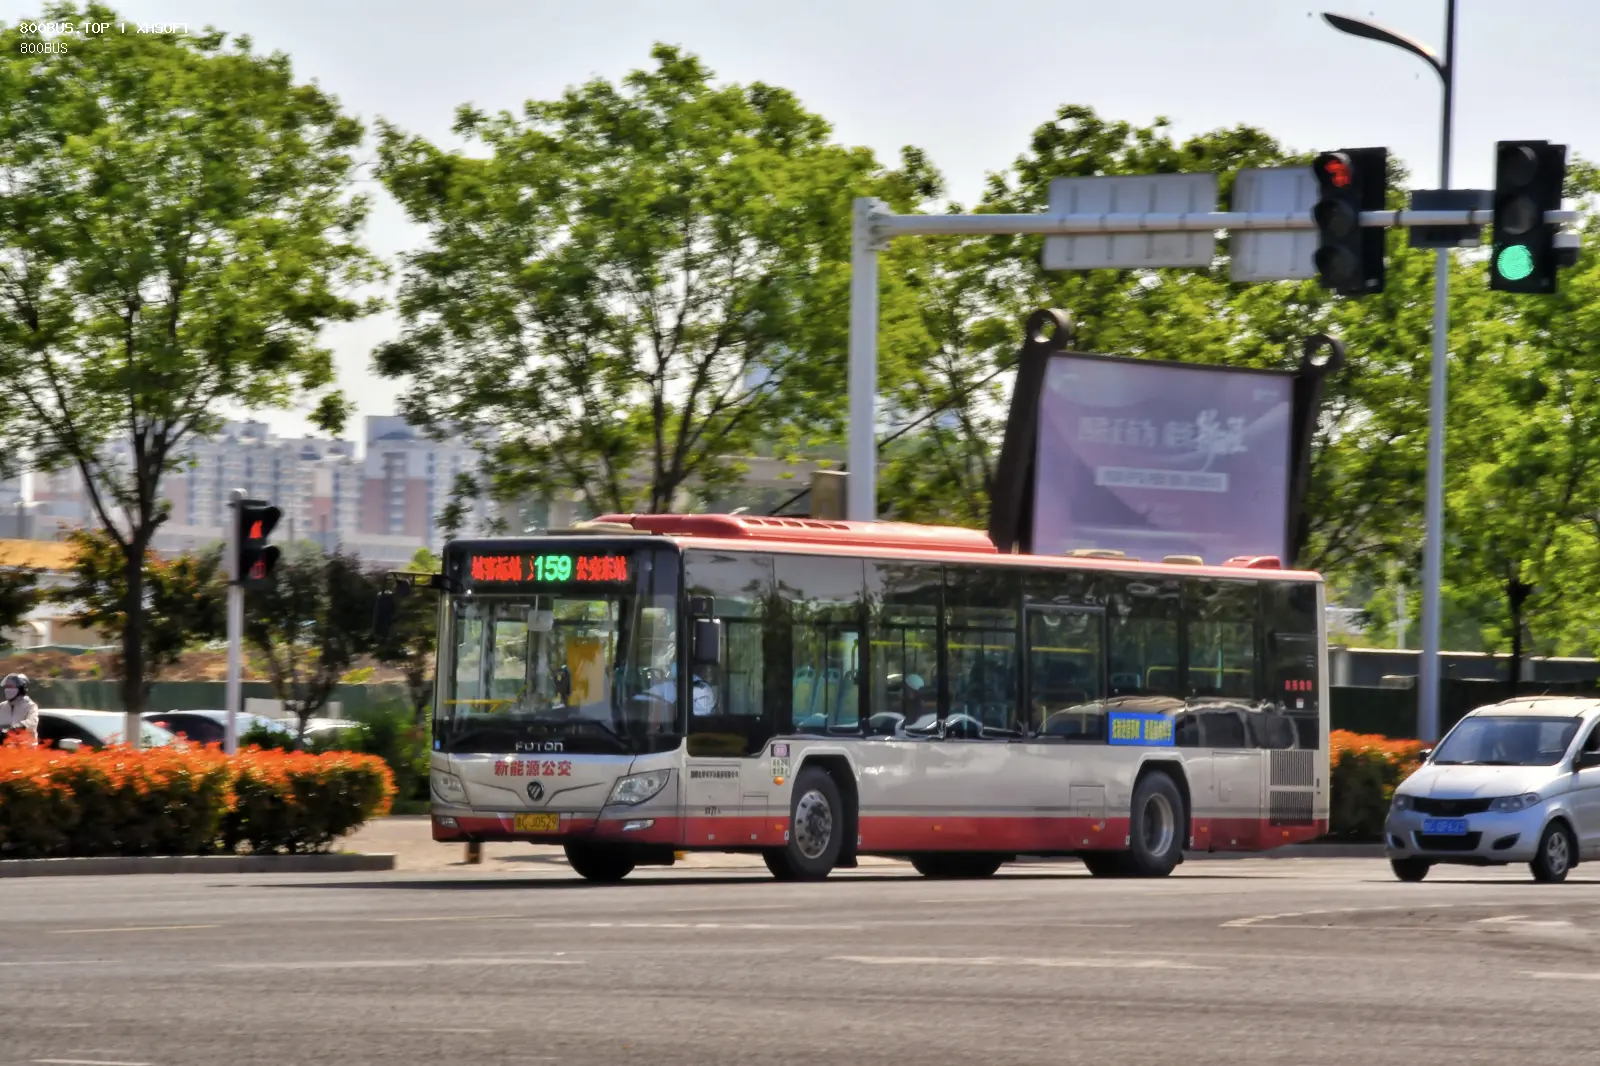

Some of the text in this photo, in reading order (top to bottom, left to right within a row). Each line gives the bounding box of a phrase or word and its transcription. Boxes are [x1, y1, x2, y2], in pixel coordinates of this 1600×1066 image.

[534, 555, 572, 581] 159
[515, 741, 564, 752] FOTON
[494, 760, 572, 777] 新能源公交
